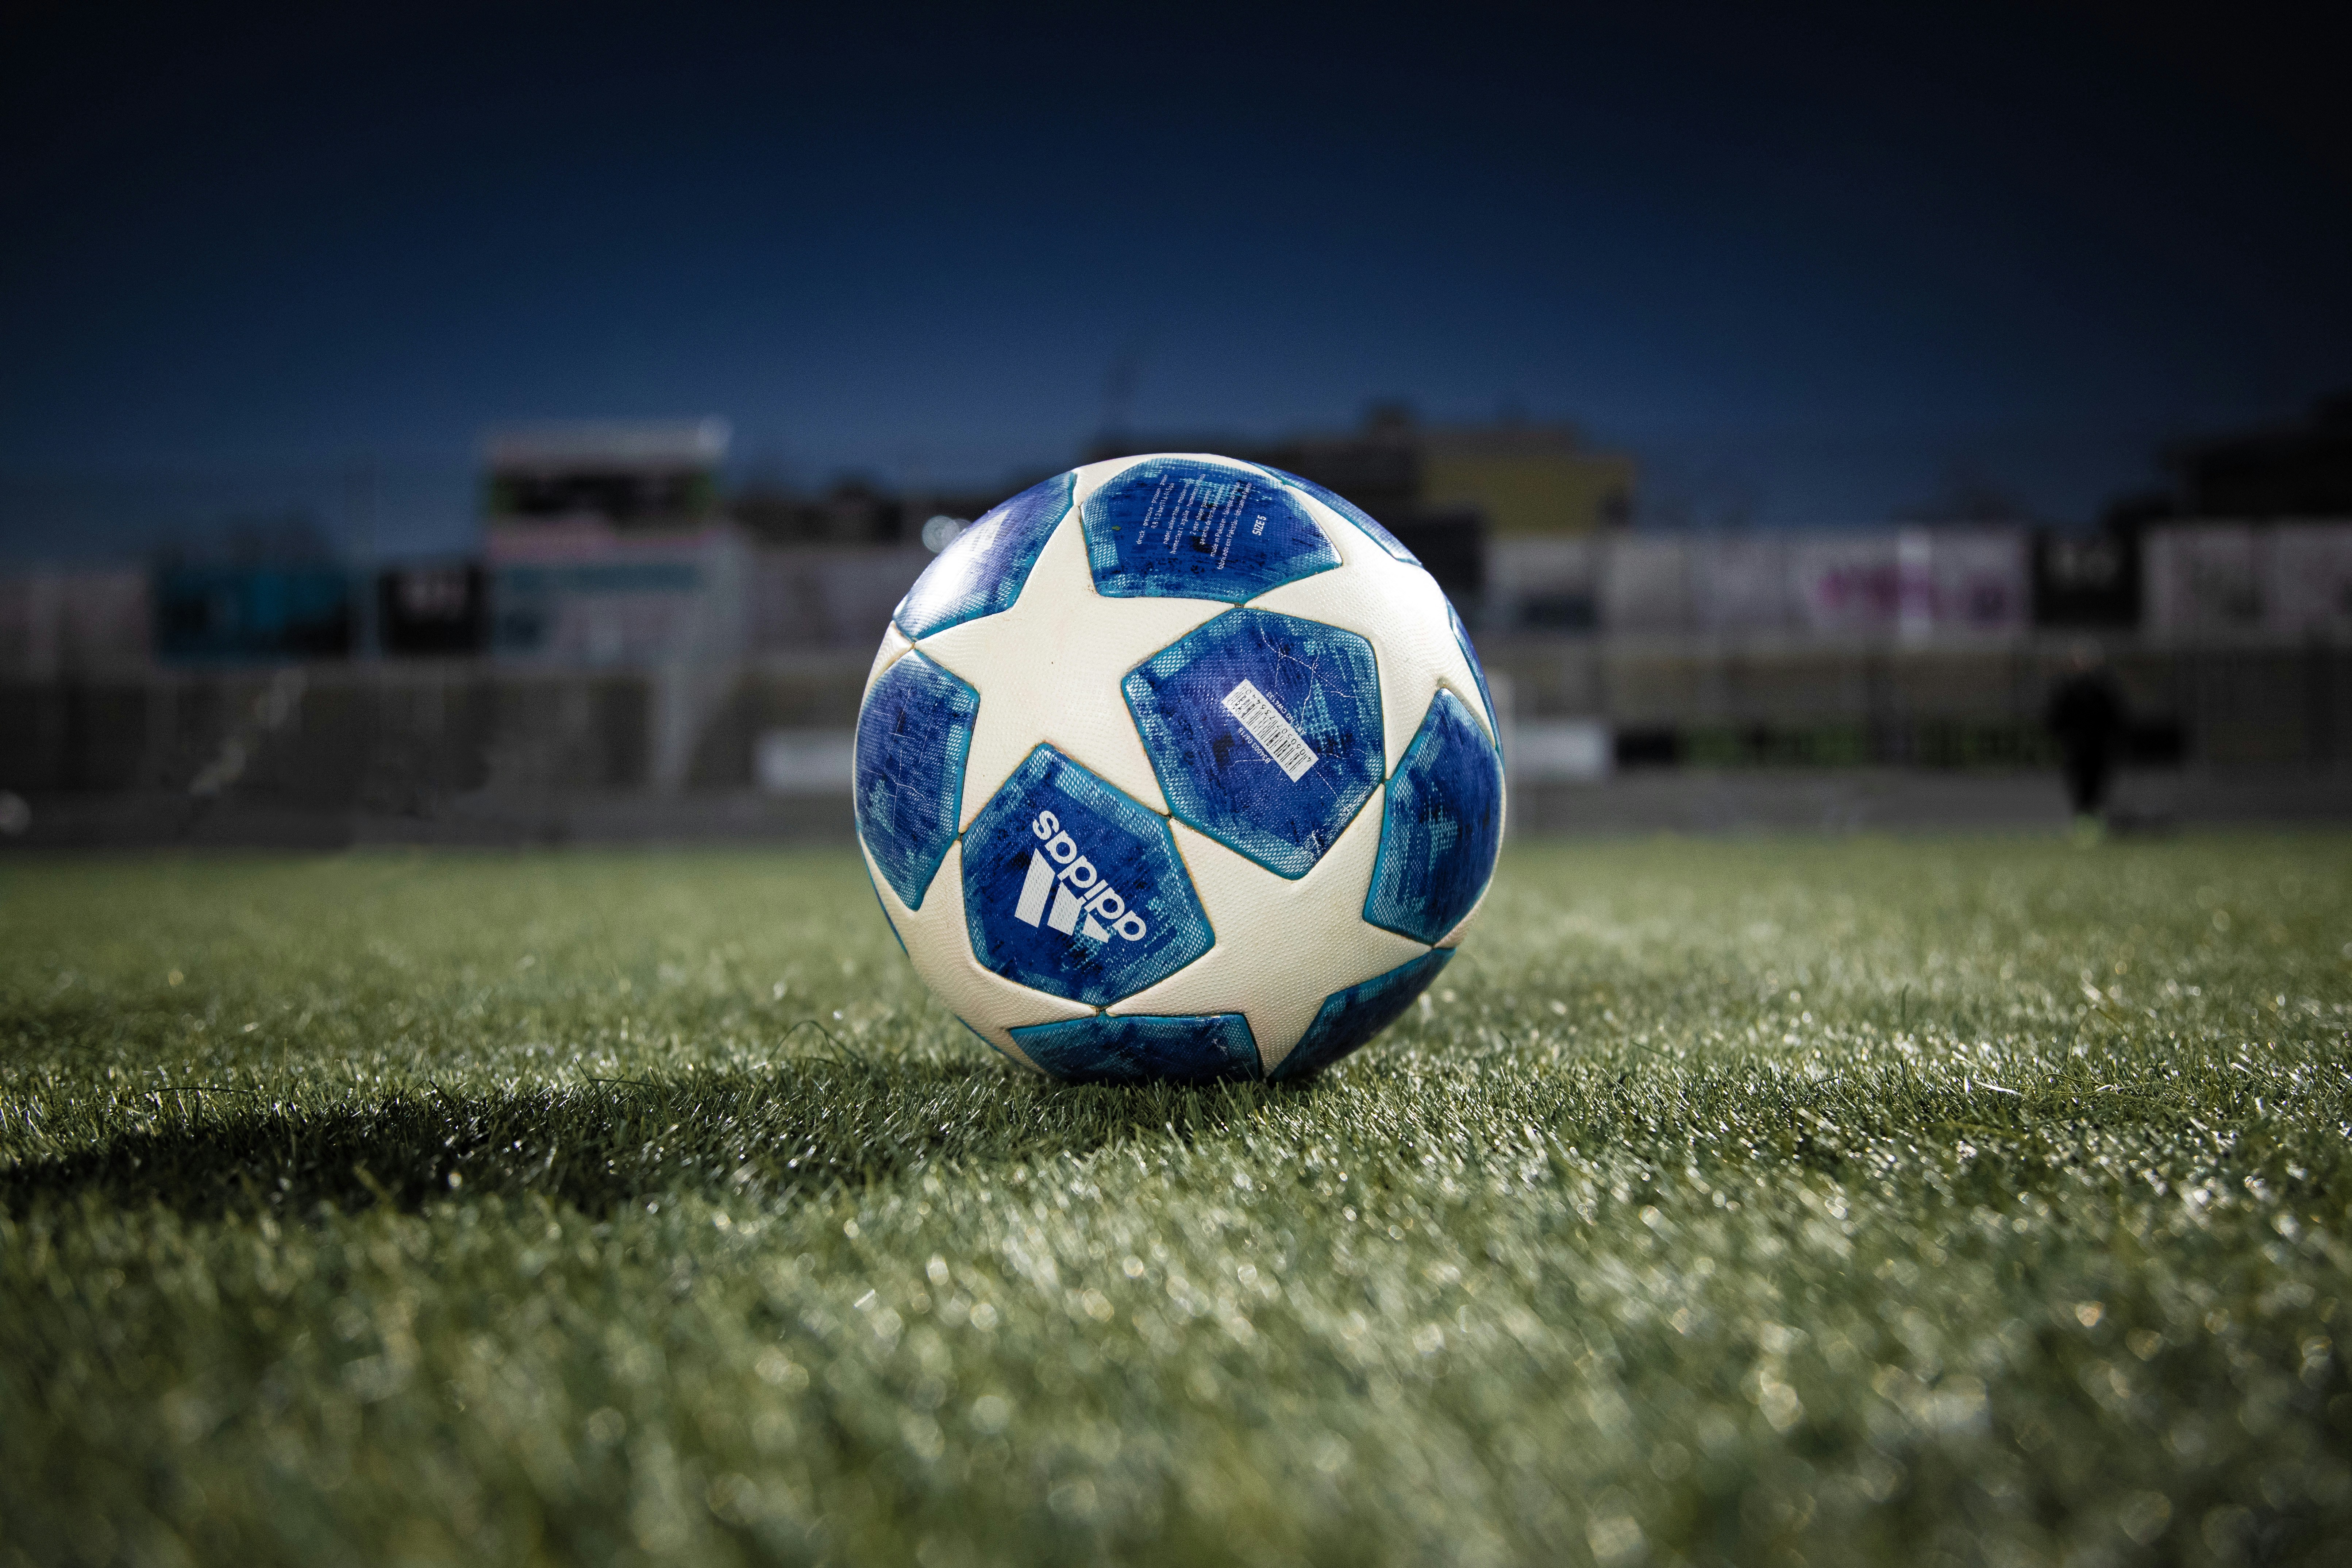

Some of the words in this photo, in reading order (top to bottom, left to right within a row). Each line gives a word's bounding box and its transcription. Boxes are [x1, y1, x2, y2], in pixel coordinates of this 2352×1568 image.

[1136, 530, 1146, 544] druck
[1143, 506, 1154, 526] pressure
[1196, 508, 1205, 520] shape
[1163, 531, 1171, 544] nadel
[1210, 543, 1219, 557] made
[1215, 519, 1227, 537] Pakistan
[1252, 519, 1265, 536] SIZE
[1217, 547, 1229, 570] fabricado
[1225, 538, 1232, 546] em
[1266, 691, 1287, 714] CW4133
[1286, 713, 1295, 723] NO
[1237, 727, 1253, 744] 06/18
[1251, 742, 1271, 764] B34003
[1032, 810, 1146, 941] adidas
